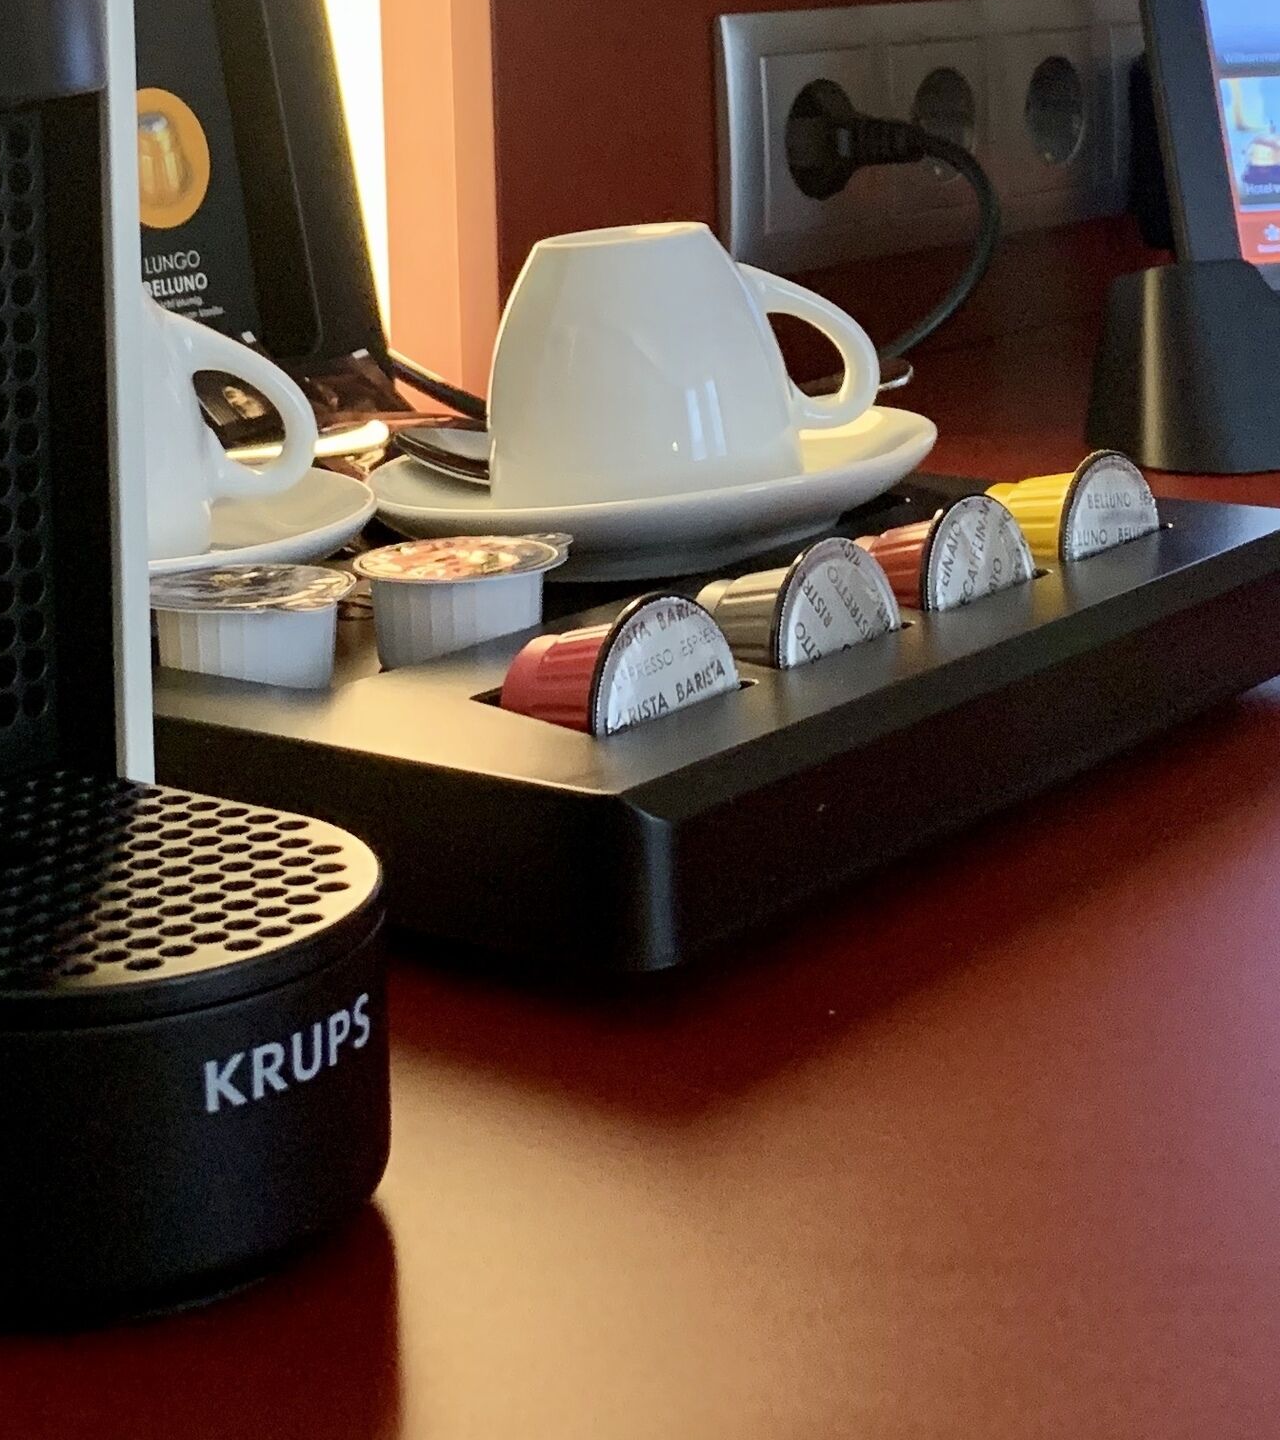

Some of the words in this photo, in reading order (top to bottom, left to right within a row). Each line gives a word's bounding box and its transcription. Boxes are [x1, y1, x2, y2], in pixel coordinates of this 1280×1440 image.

[144, 249, 201, 275] LUNGO
[142, 272, 208, 297] BELLUNO
[1087, 491, 1132, 510] BELLUNO
[675, 658, 726, 703] BARISTA
[204, 992, 371, 1114] KRUPS
